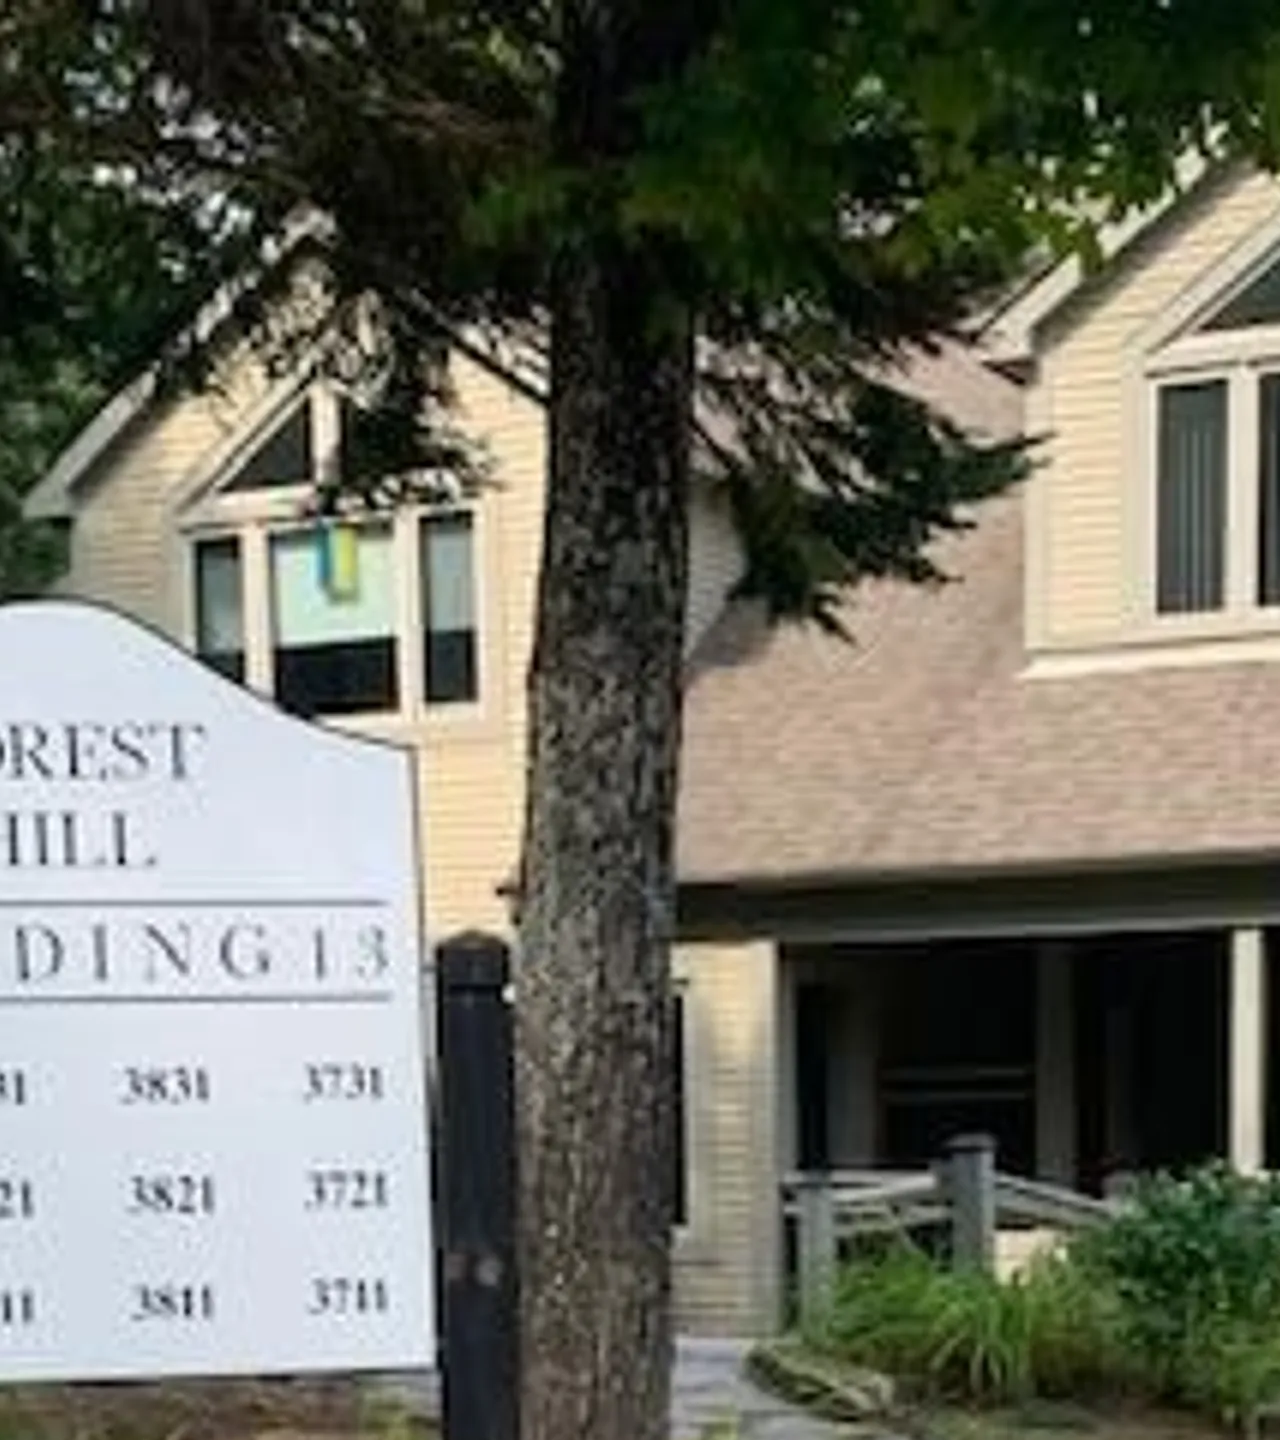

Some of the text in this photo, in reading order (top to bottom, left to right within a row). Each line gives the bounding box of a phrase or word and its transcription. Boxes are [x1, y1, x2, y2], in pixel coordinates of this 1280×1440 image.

[312, 923, 390, 982] 13
[119, 1064, 210, 1106] 3831
[302, 1061, 385, 1103] 3731
[126, 1173, 216, 1216] 3821
[303, 1168, 389, 1210] 3721
[130, 1283, 215, 1322] 3811
[307, 1276, 389, 1316] 3711
